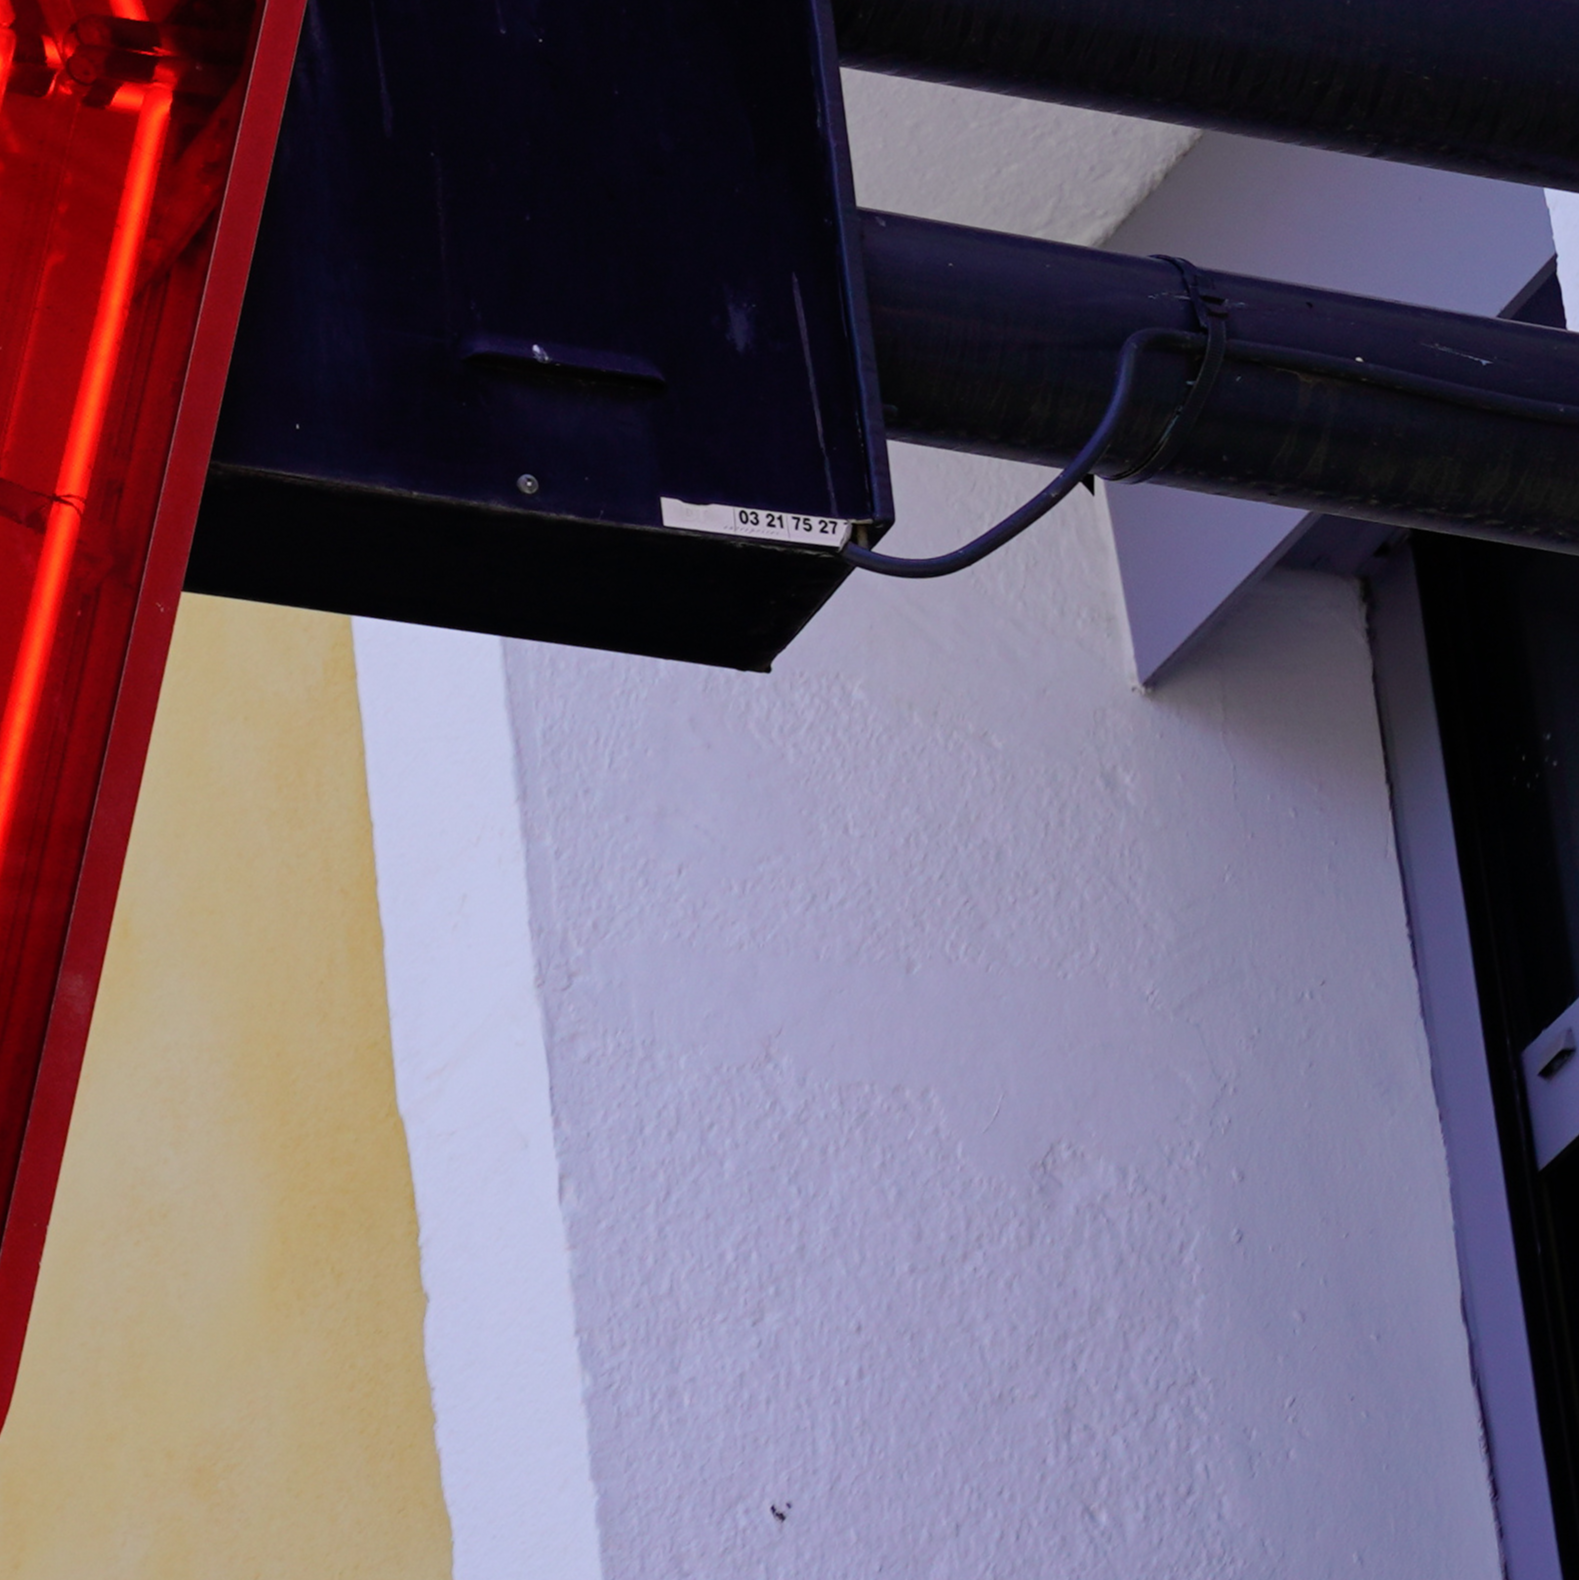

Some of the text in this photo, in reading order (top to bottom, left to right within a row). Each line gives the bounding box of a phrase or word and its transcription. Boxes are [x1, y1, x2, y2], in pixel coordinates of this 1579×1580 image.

[738, 509, 760, 526] 03
[766, 513, 785, 529] 21
[791, 516, 813, 532] 75
[818, 519, 838, 535] 27
